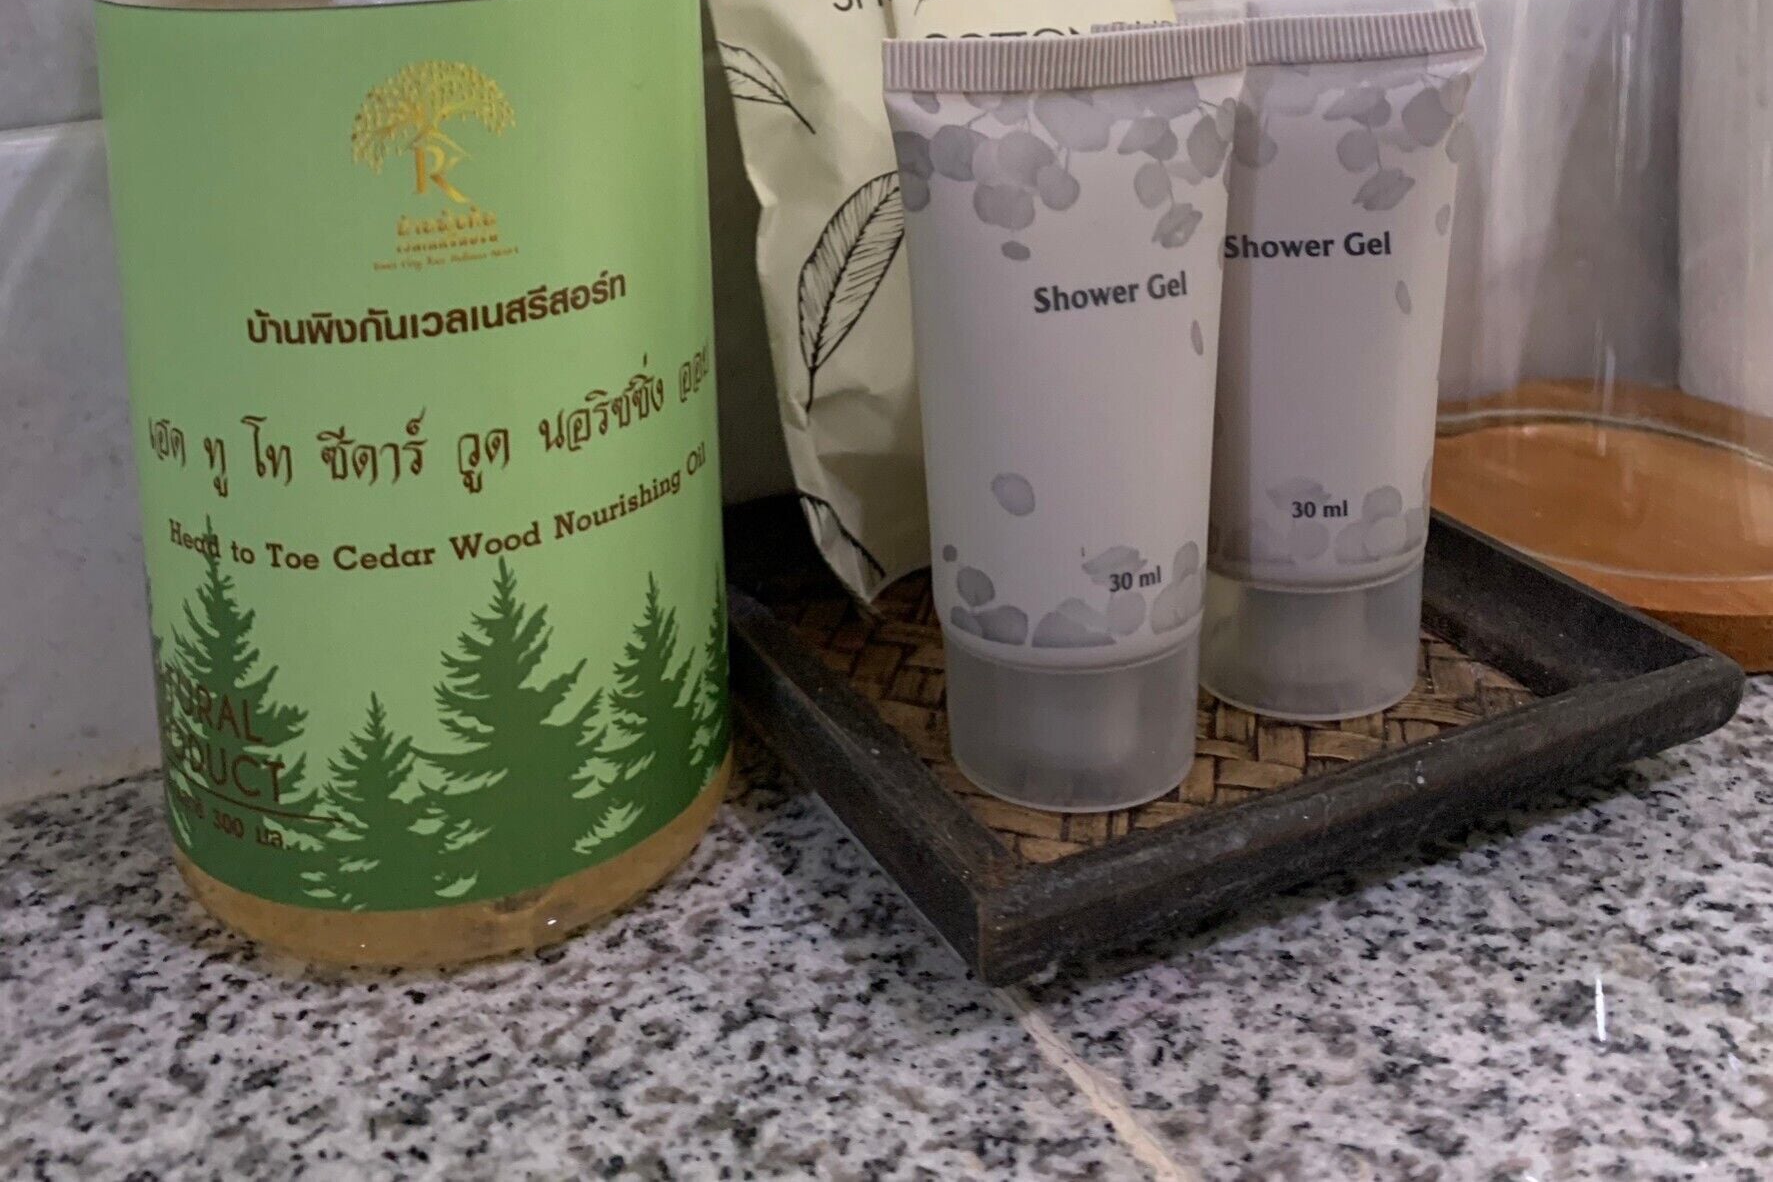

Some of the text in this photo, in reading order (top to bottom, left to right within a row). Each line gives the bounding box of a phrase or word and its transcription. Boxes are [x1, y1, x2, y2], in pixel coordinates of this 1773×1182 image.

[1223, 231, 1391, 259] Shower Gel
[1034, 270, 1188, 314] Shower Gel
[203, 436, 229, 499] ทู
[241, 414, 293, 487] โท
[316, 405, 428, 487] ซีดาร์
[457, 427, 510, 495] วูด
[168, 441, 707, 571] Head to Toe Cedar Wood Nourishing Oil
[1291, 499, 1349, 519] 30 ml
[1108, 565, 1162, 593] 30 ml
